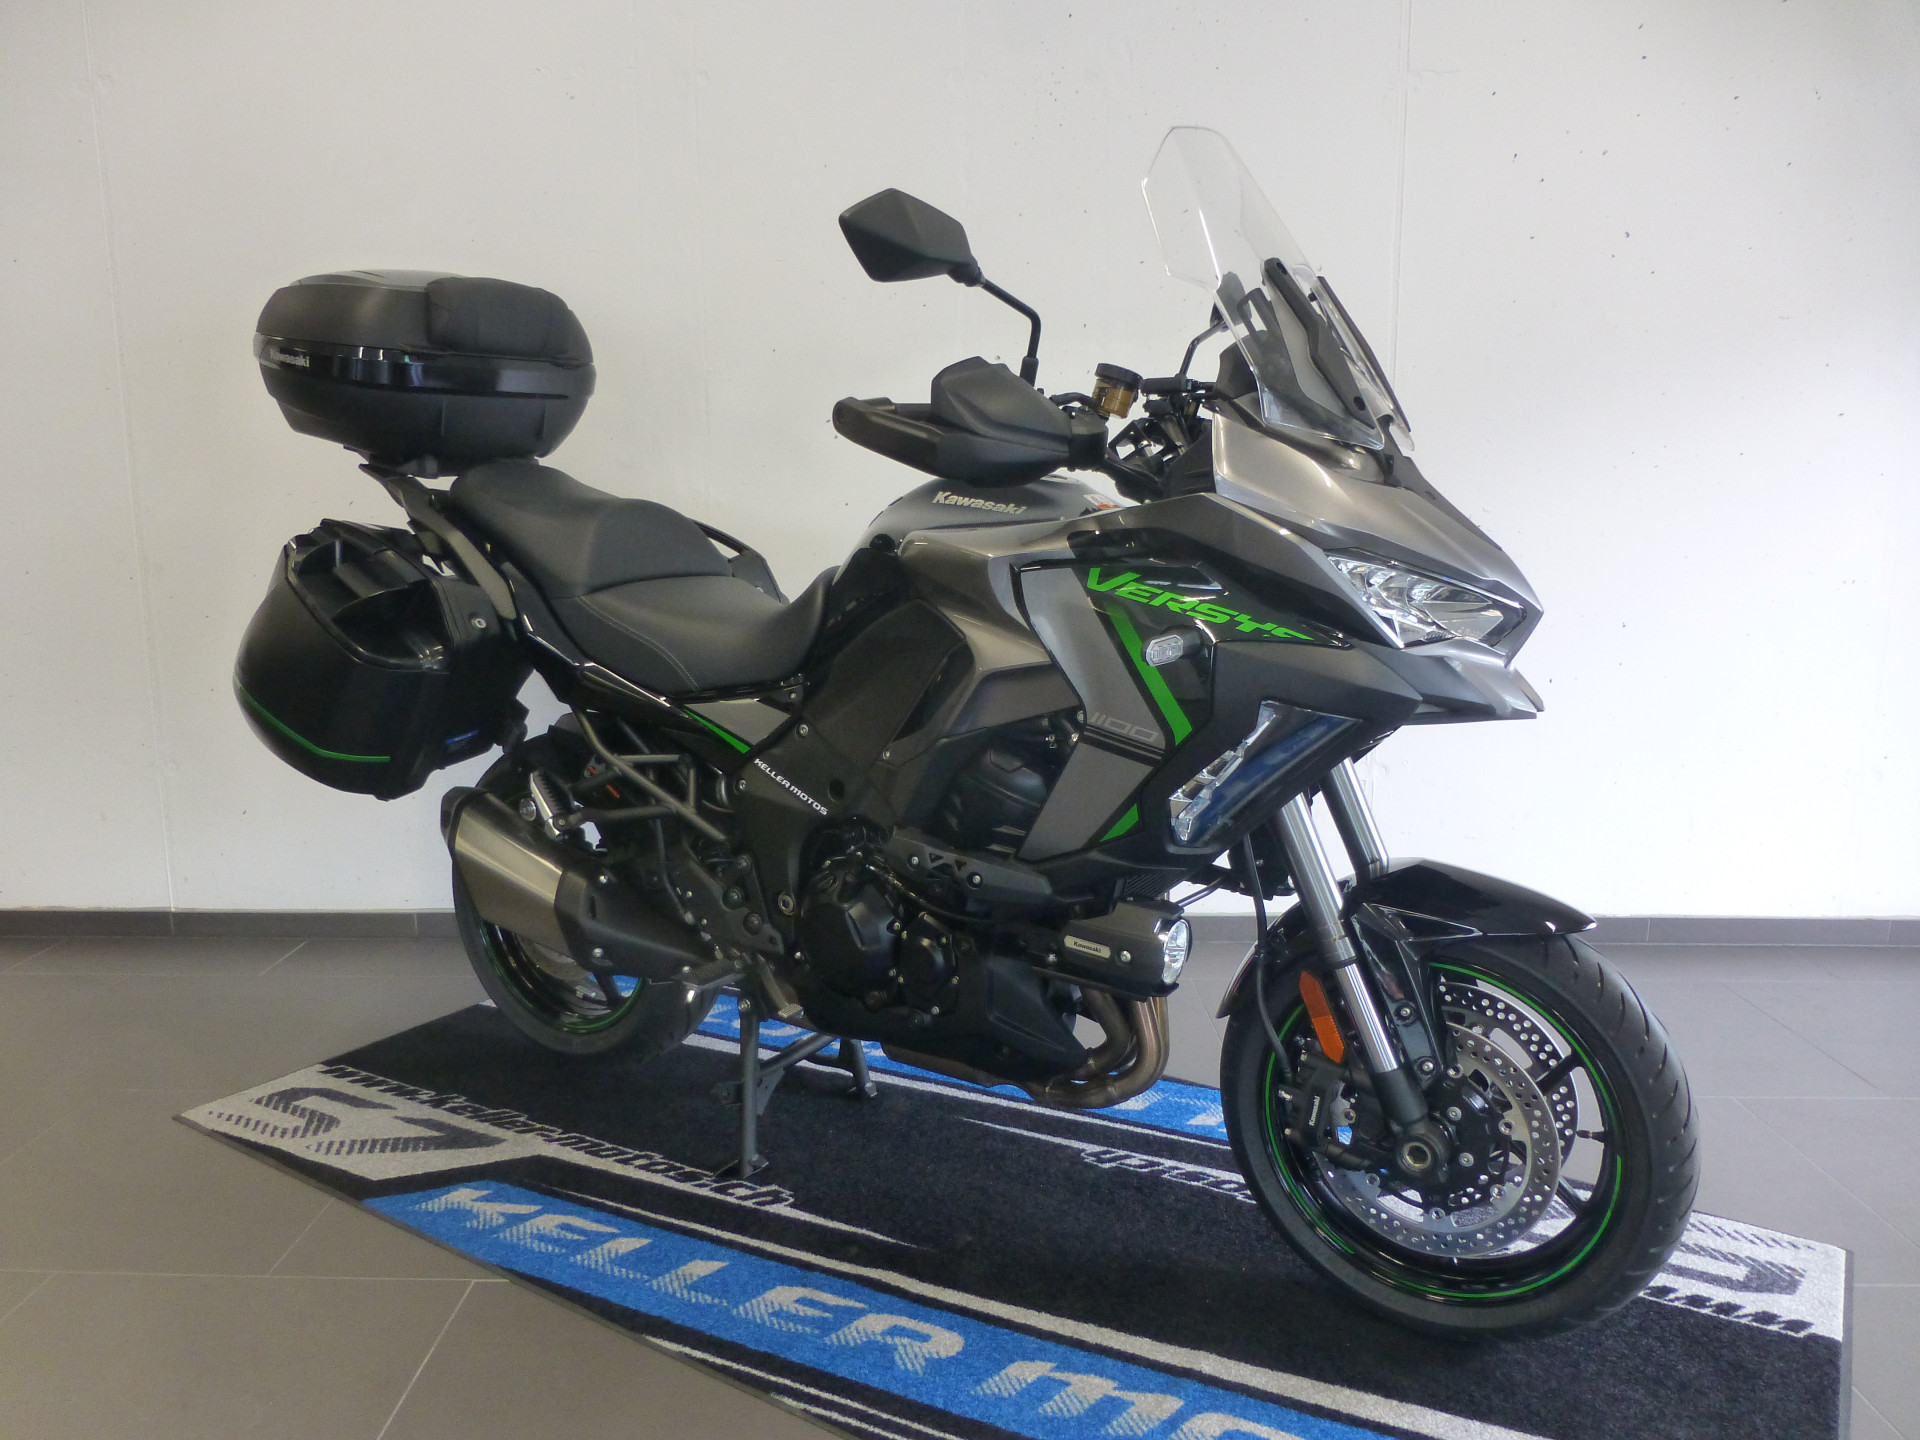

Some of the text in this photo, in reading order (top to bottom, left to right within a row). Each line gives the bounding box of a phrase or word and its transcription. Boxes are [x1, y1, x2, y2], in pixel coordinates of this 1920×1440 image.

[932, 491, 1028, 515] Kawasaki
[1090, 711, 1159, 742] 1100
[754, 758, 829, 815] KELLER MOTOS
[1073, 940, 1103, 953] Kawasaki
[412, 1187, 966, 1376] KELLER
